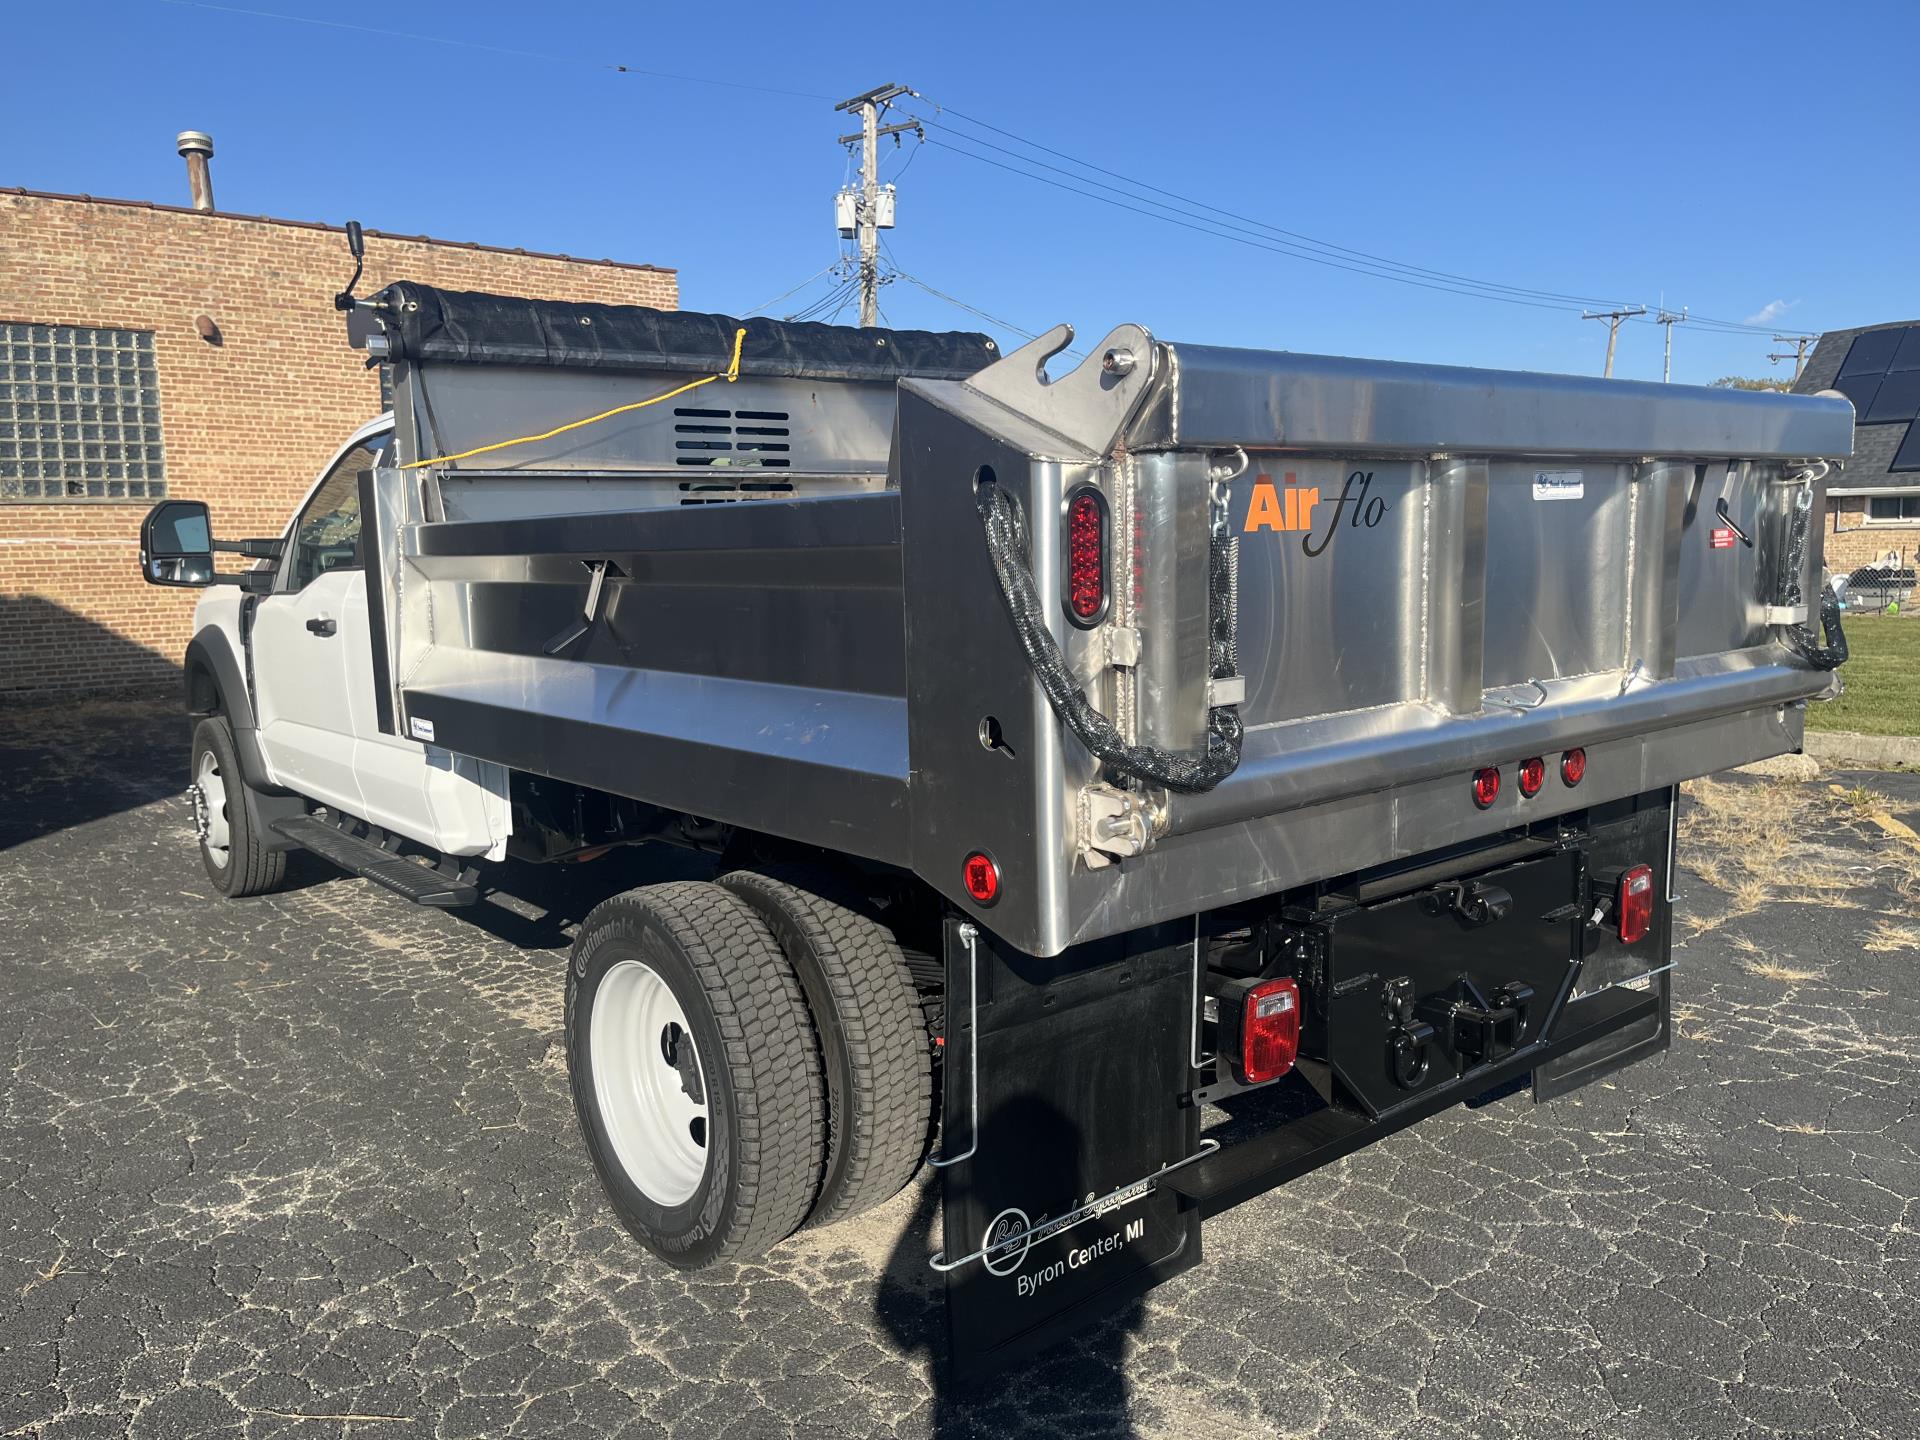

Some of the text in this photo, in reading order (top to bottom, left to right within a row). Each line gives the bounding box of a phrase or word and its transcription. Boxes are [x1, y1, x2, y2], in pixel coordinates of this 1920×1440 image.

[575, 917, 626, 978] Continental
[831, 1087, 840, 1130] 225/70
[681, 1225, 705, 1251] Conti
[1017, 1217, 1144, 1297] Byron Center, MI
